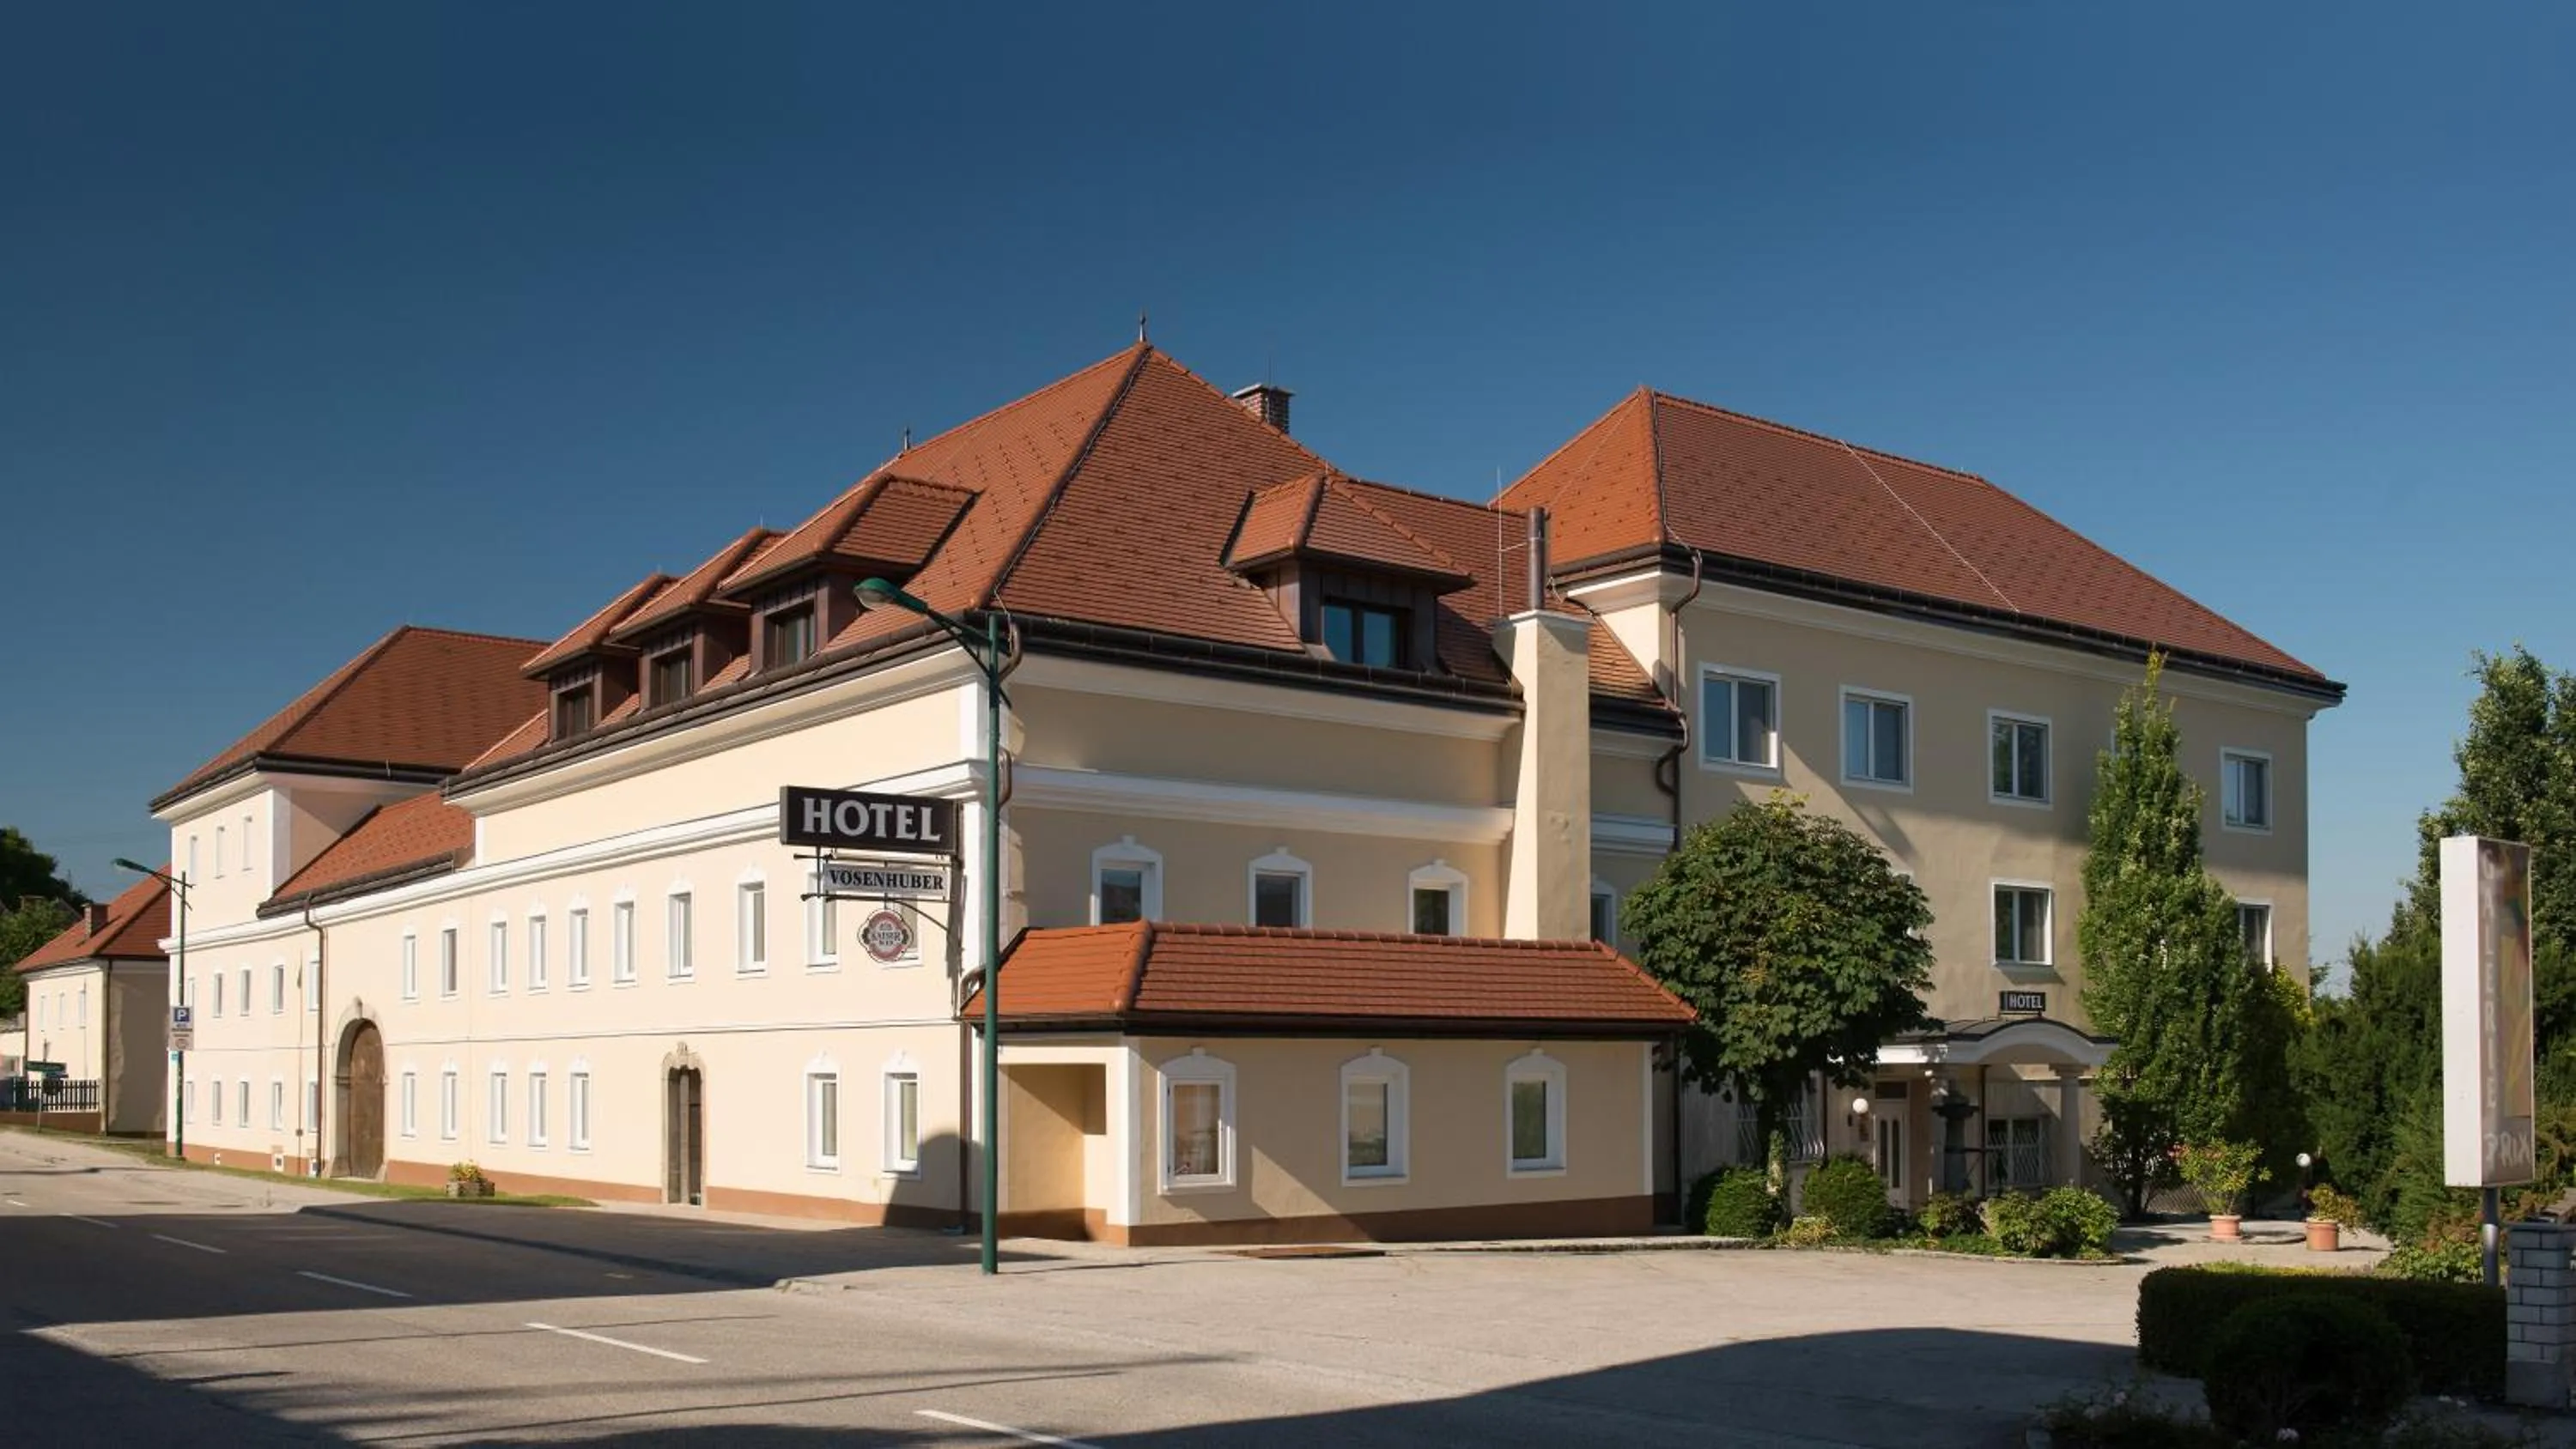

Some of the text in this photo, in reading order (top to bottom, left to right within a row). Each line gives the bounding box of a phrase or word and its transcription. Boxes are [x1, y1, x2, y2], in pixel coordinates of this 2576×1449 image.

[803, 797, 941, 841] HOTEL
[2009, 994, 2043, 1008] HOTEL
[177, 1009, 187, 1021] P
